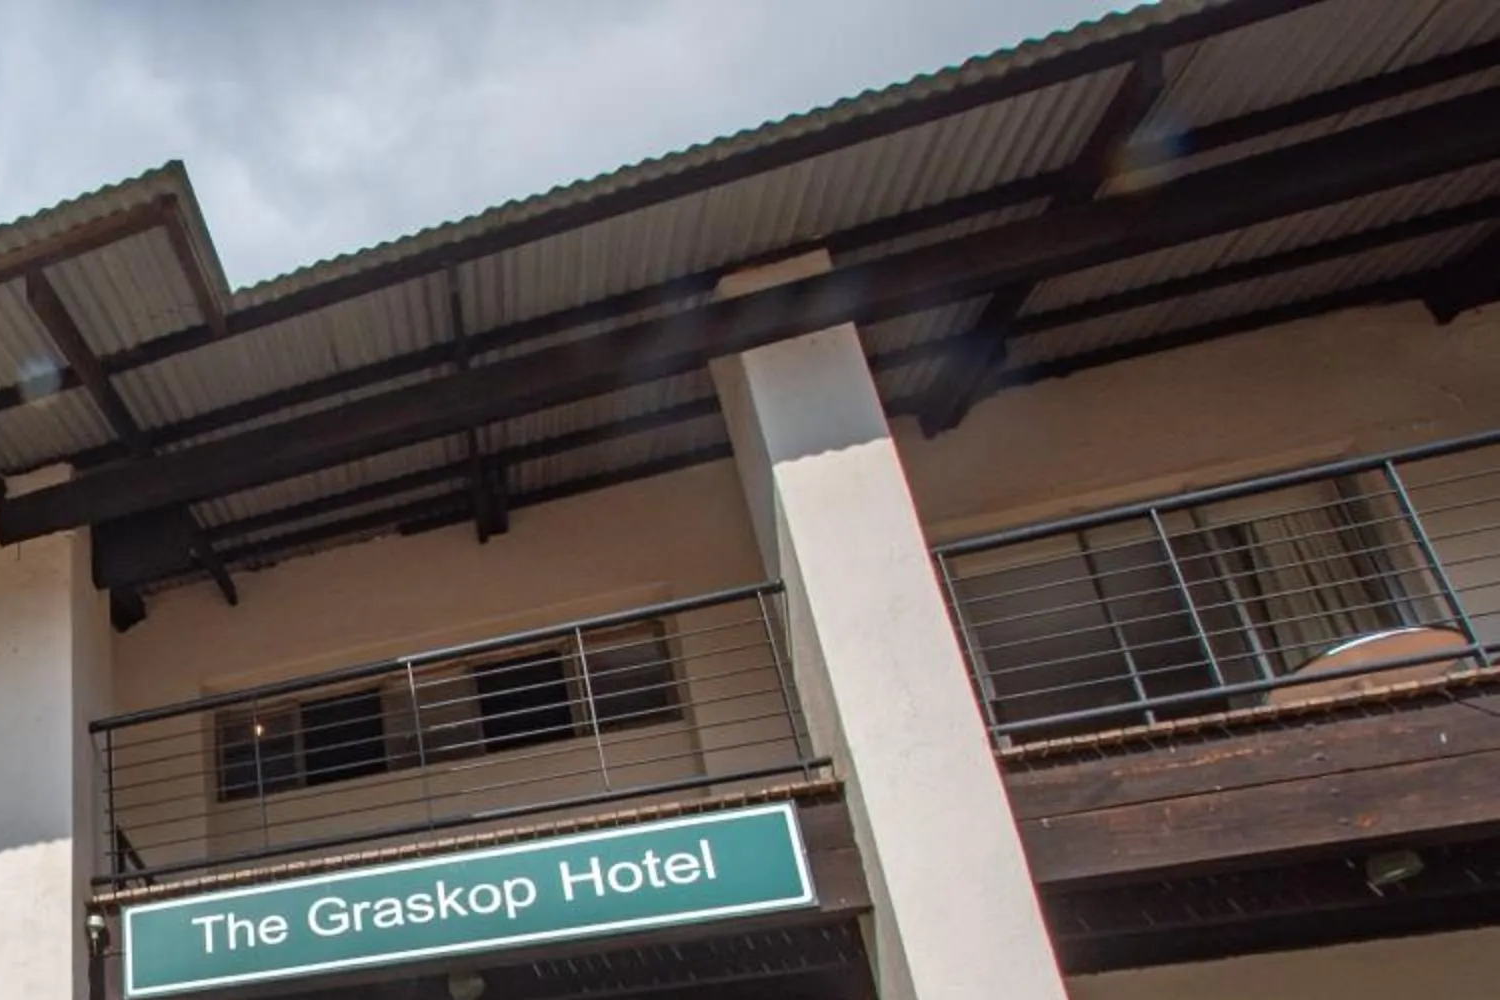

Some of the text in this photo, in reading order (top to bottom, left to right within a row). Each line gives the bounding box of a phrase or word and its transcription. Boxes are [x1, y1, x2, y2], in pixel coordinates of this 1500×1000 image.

[191, 839, 717, 953] The Graskop Hotel
